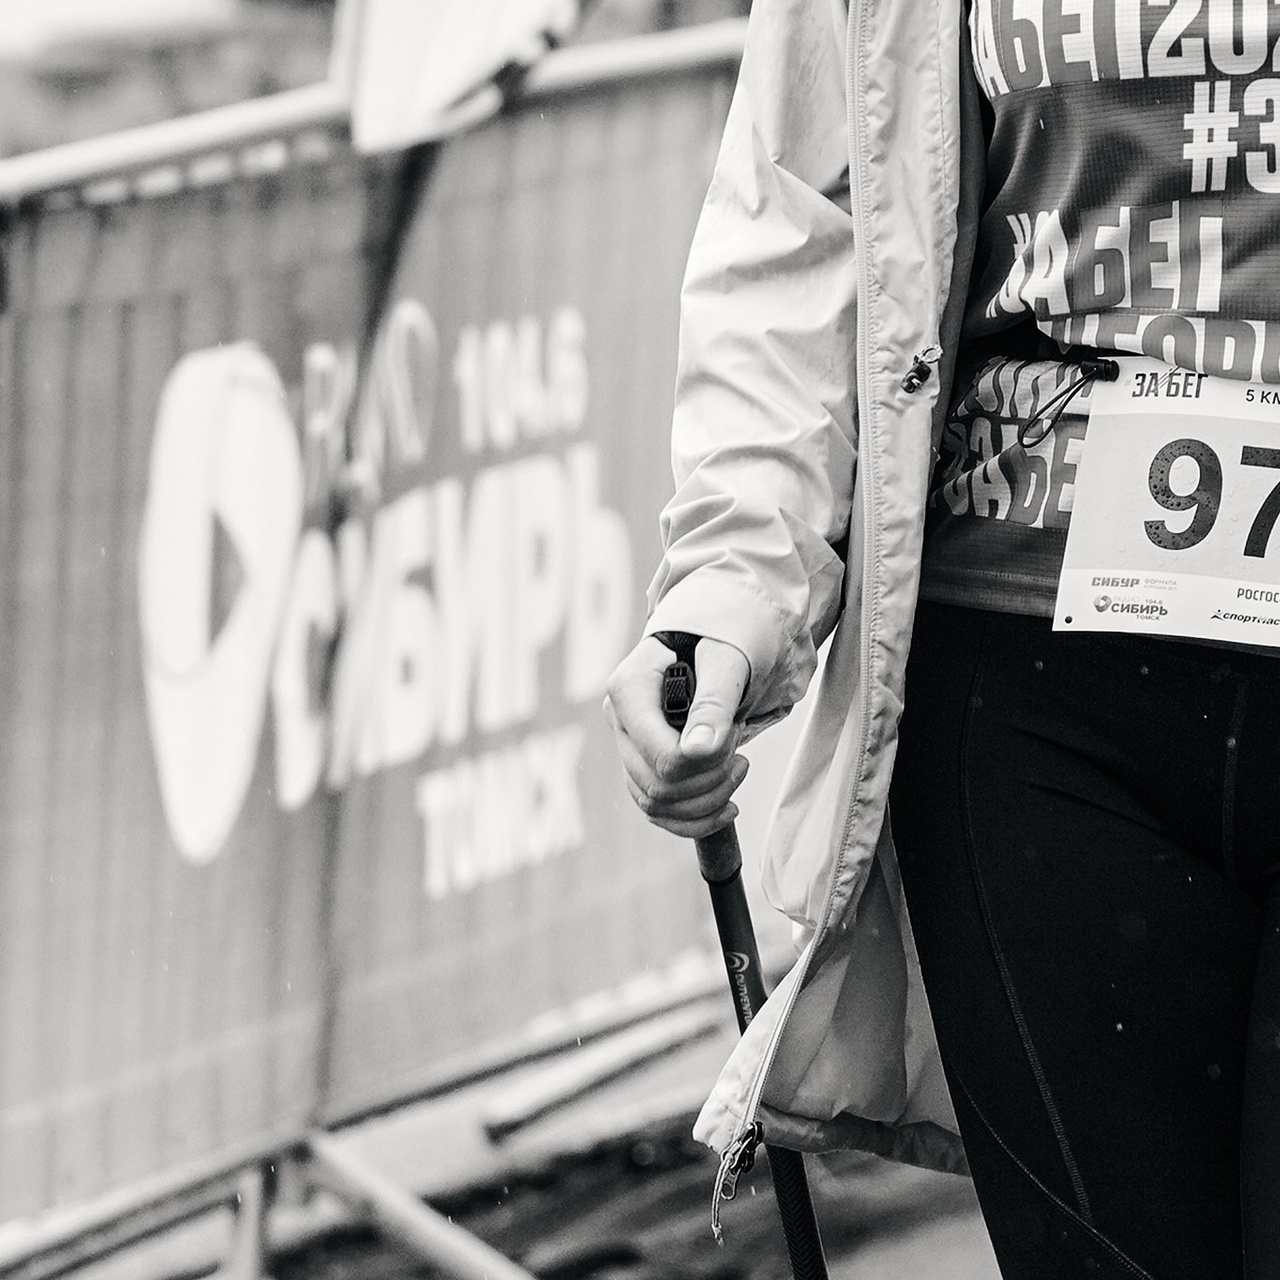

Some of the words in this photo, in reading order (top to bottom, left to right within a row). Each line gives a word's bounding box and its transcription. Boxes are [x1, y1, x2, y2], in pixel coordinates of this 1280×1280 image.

[1245, 389, 1256, 403] 5
[1091, 576, 1141, 588] СИБУР
[1110, 602, 1169, 617] СИБИРЬ
[1136, 614, 1161, 622] ТОМСК
